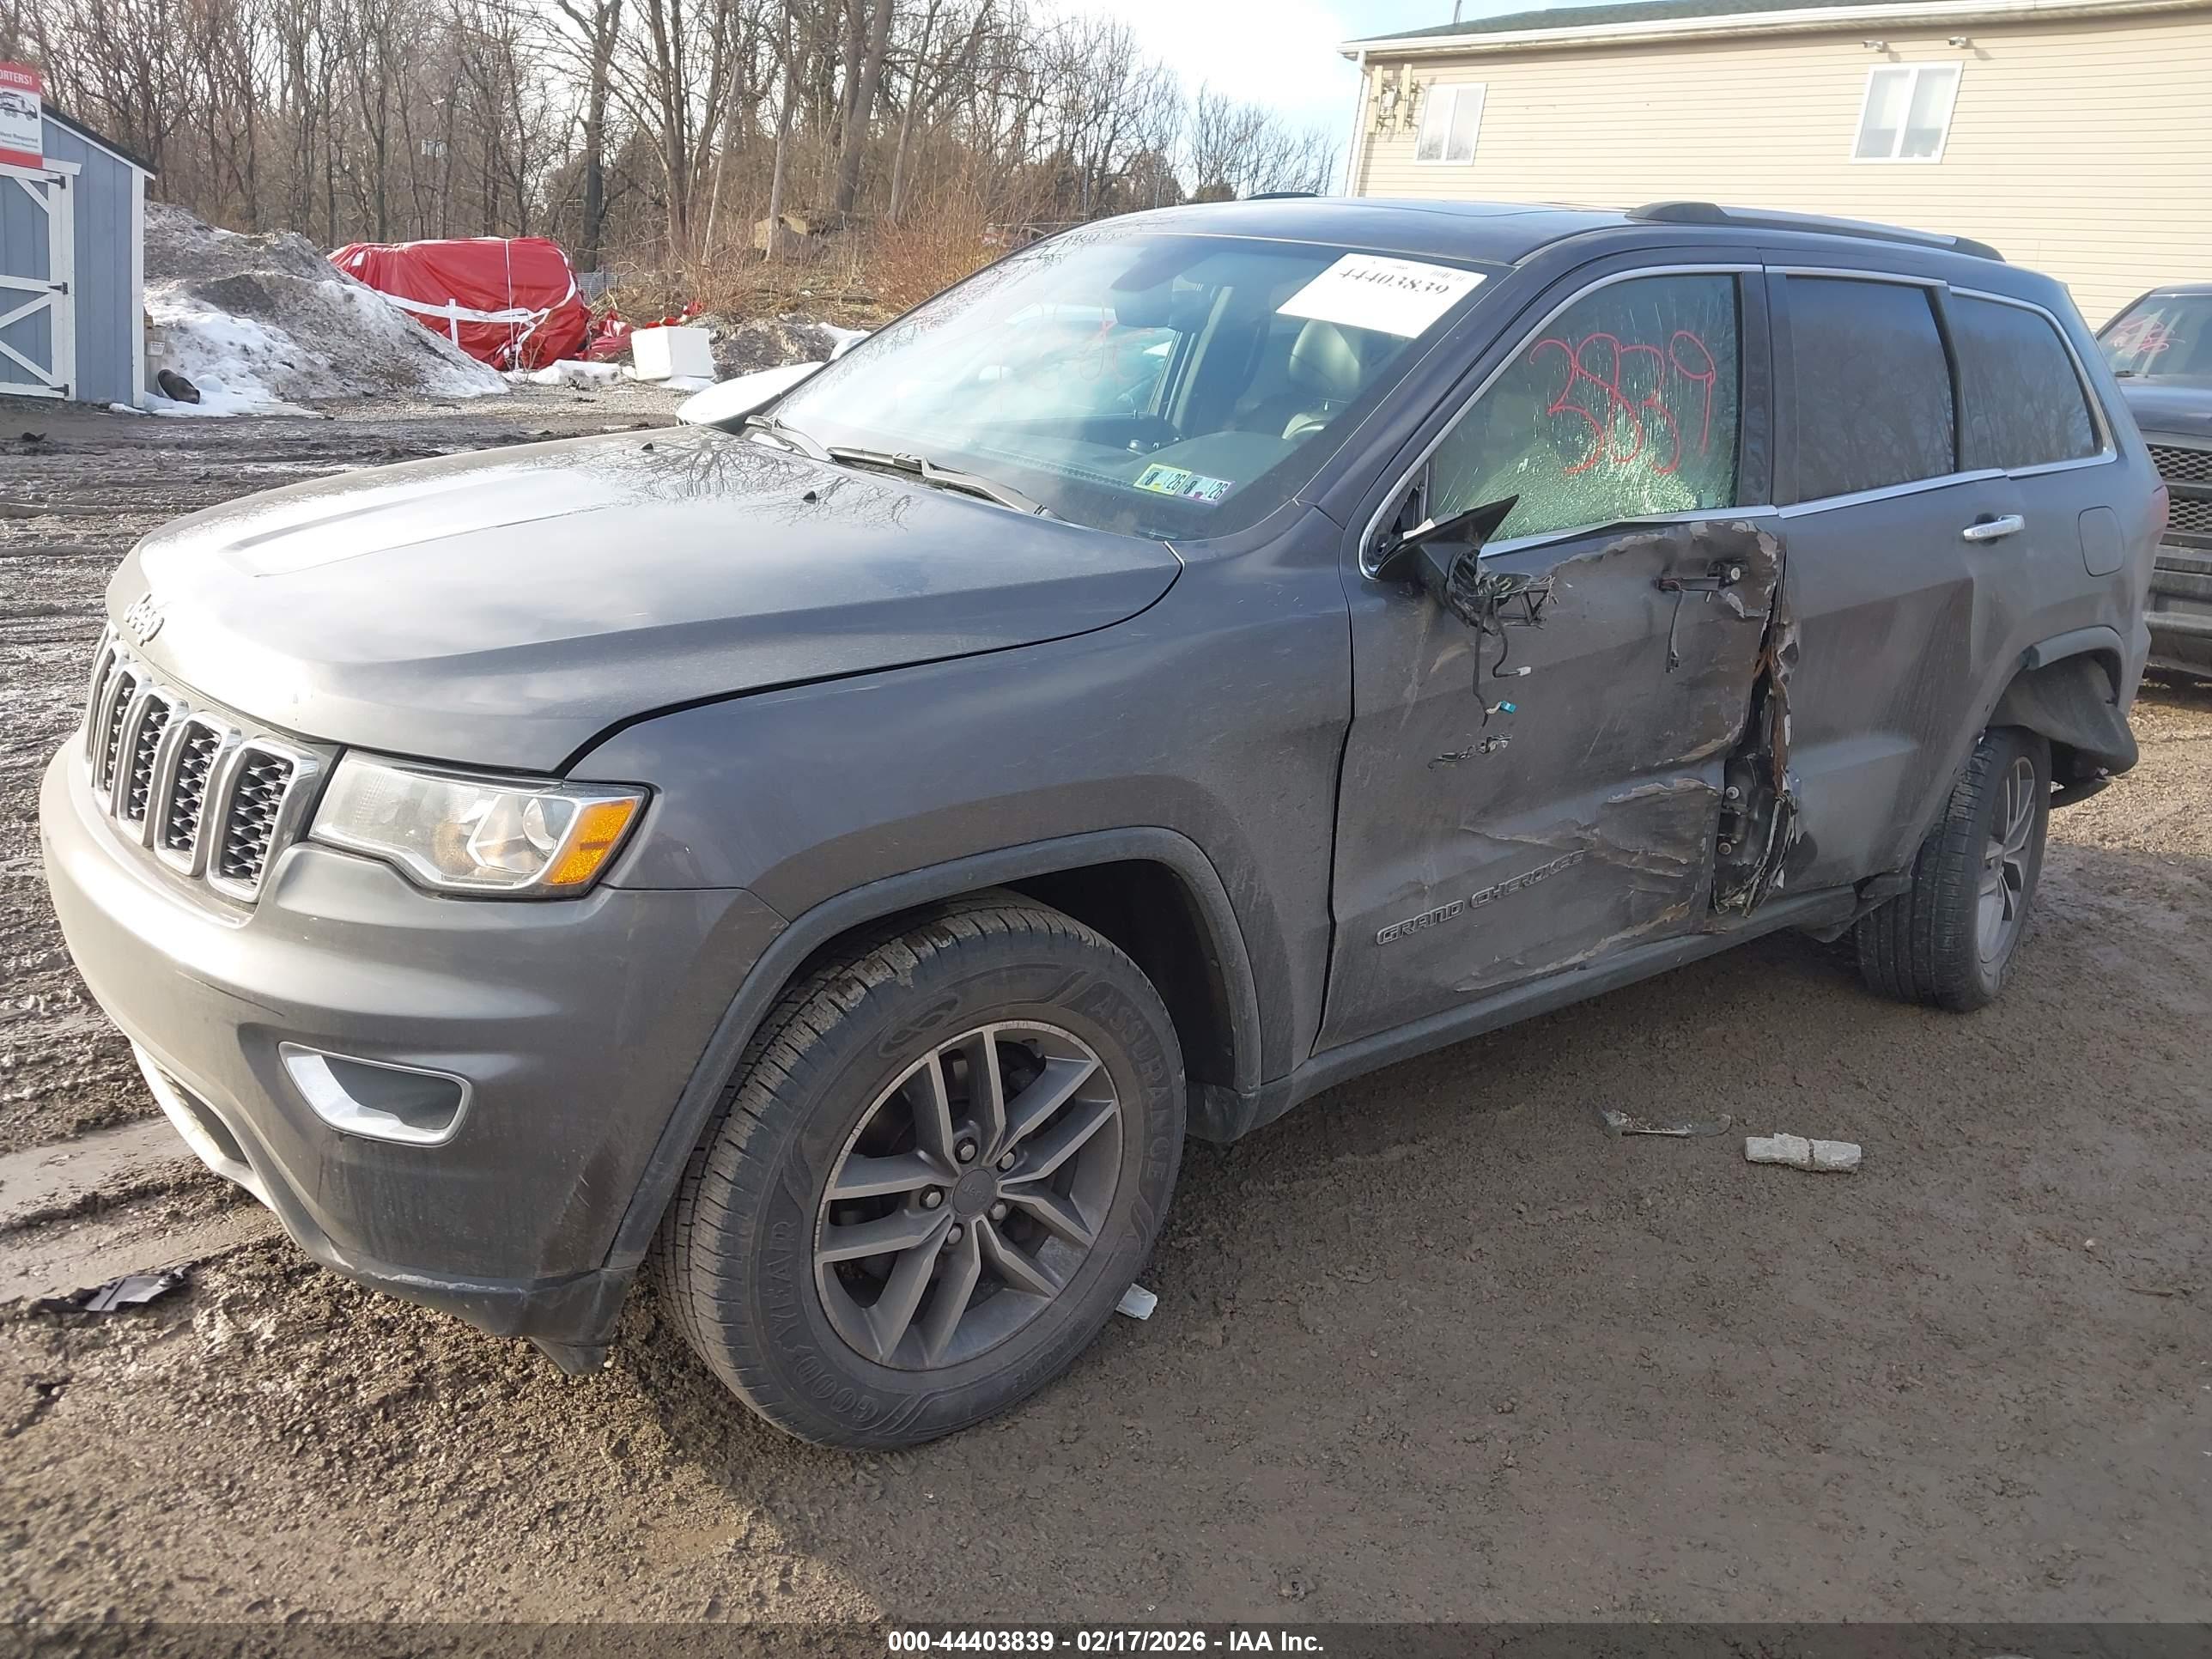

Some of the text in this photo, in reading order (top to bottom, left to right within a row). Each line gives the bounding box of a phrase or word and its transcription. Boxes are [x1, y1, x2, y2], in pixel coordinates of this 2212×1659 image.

[1528, 330, 1717, 476] 3839
[124, 592, 165, 647] Jeep
[1376, 849, 1587, 945] GRAND CHEROKEE
[1089, 990, 1170, 1183] ASSURANCE
[766, 1219, 879, 1423] GOODYEAR
